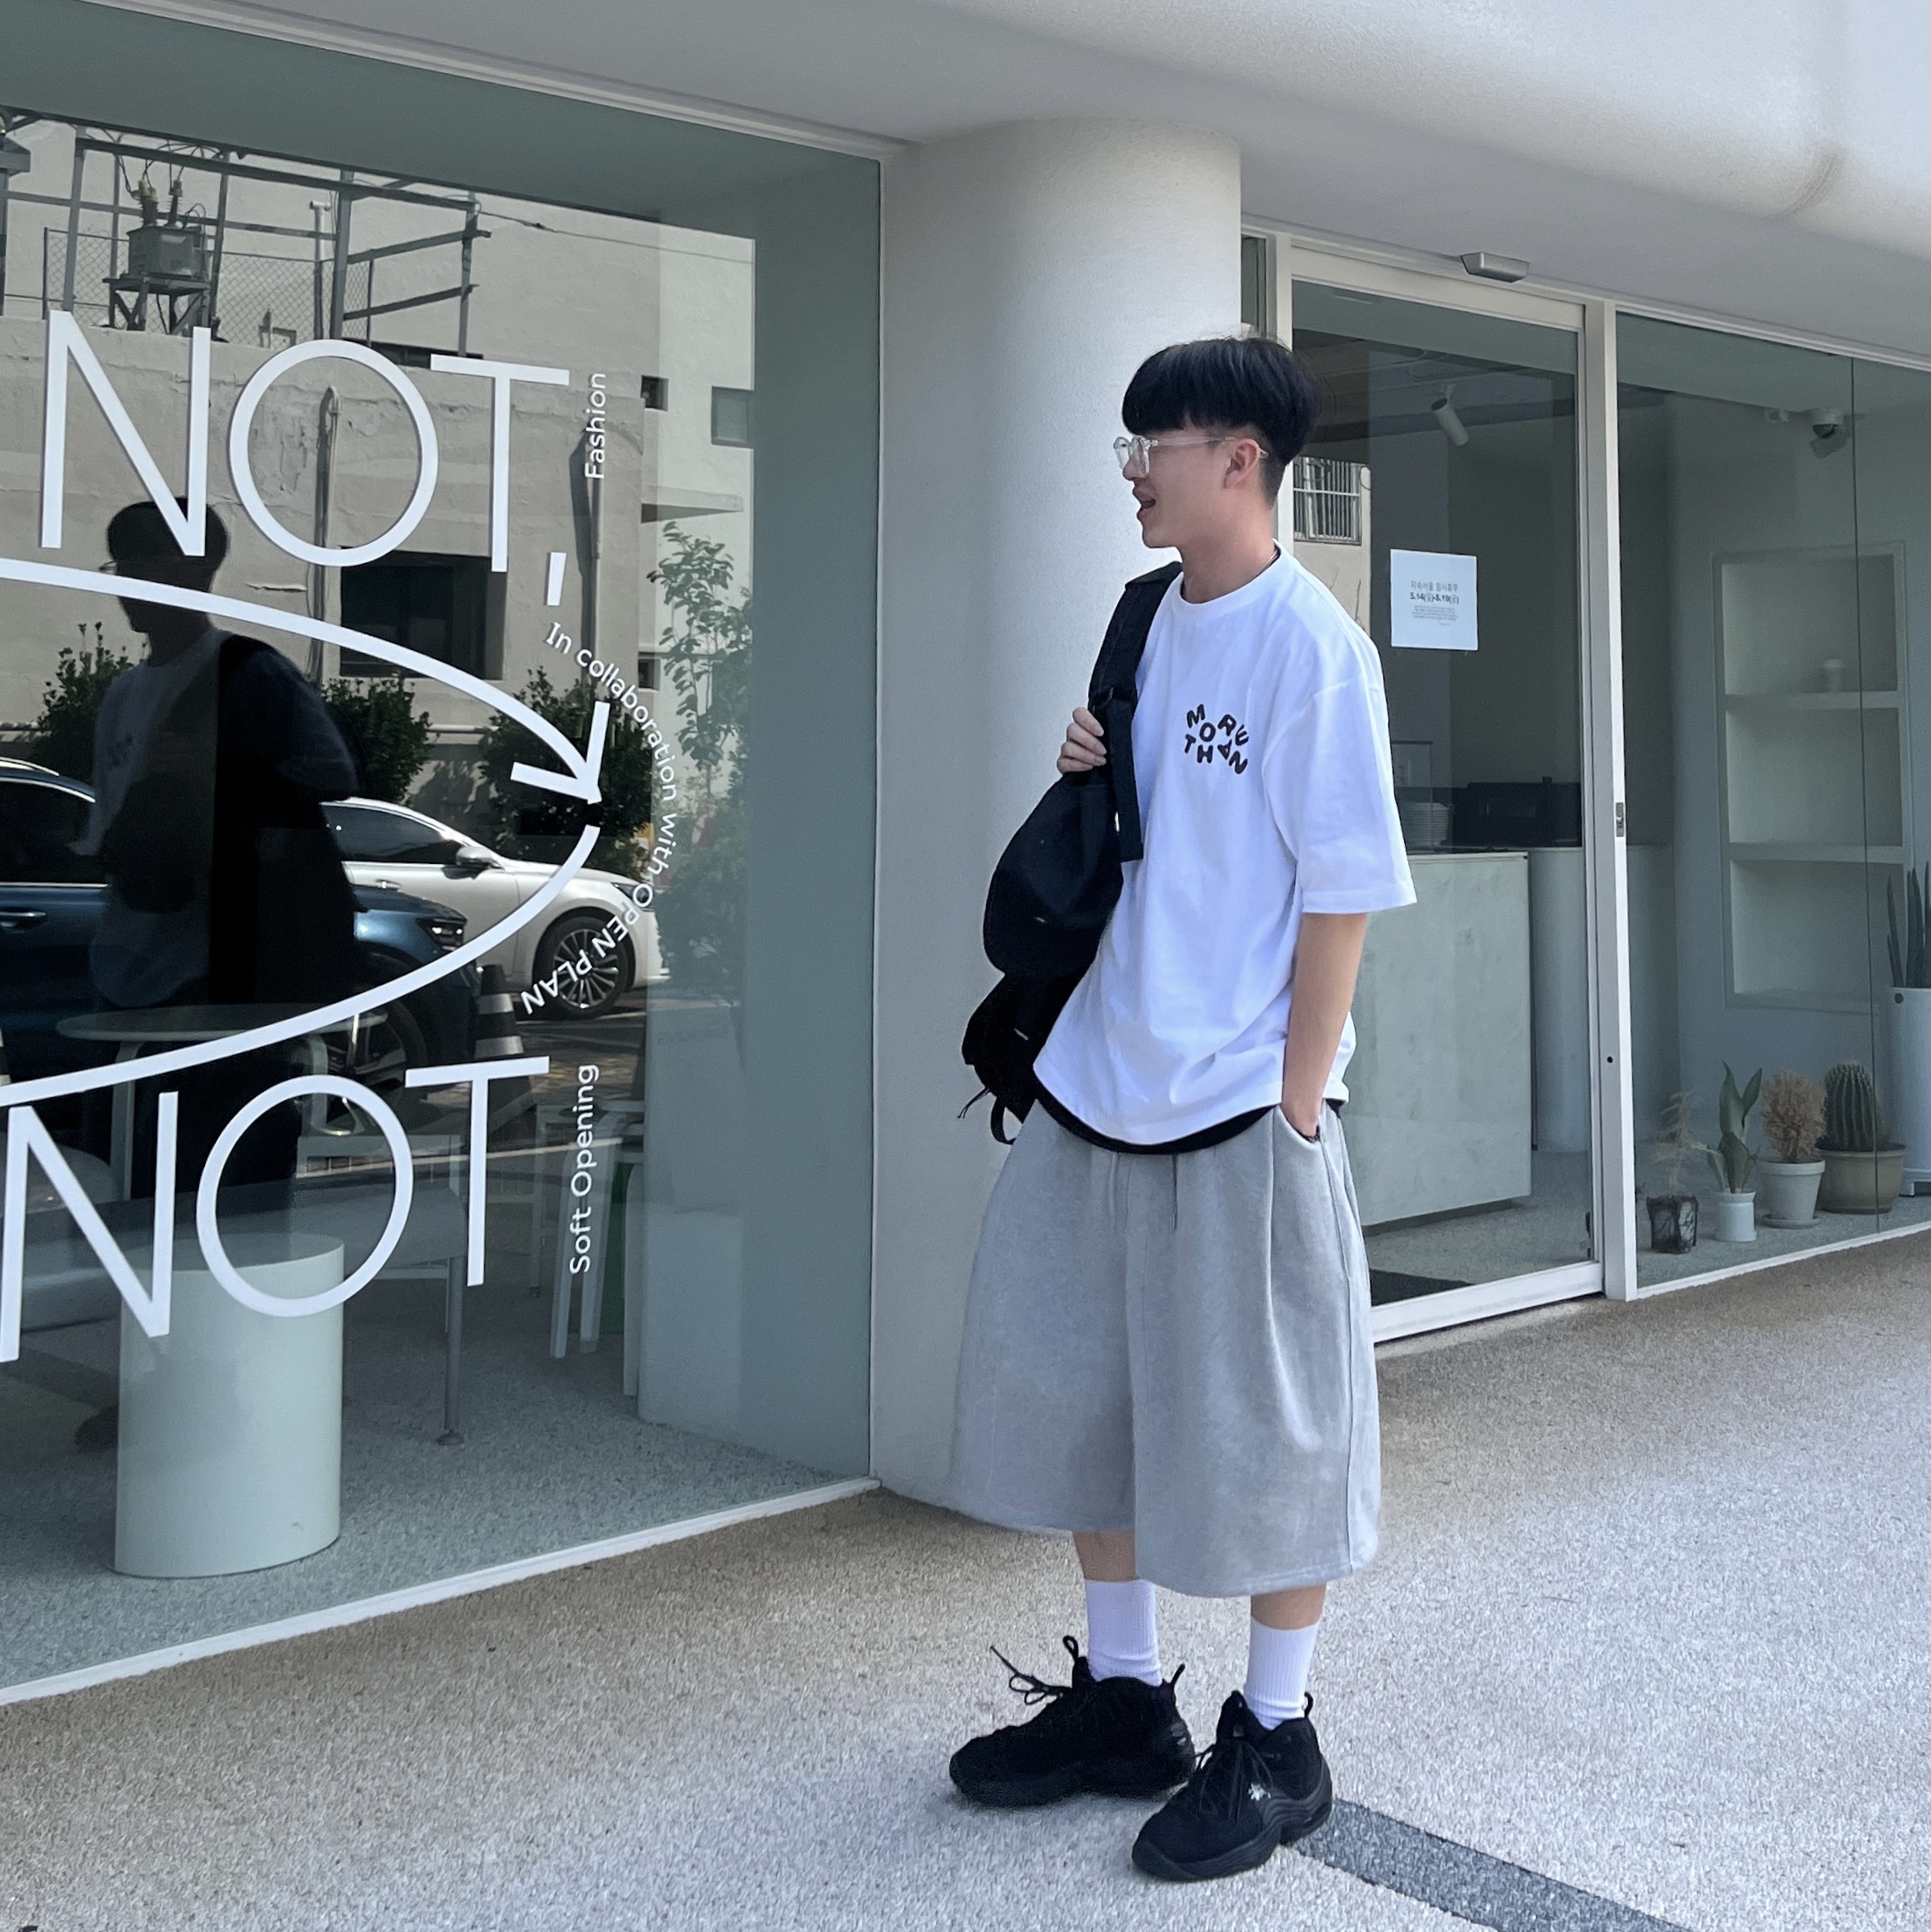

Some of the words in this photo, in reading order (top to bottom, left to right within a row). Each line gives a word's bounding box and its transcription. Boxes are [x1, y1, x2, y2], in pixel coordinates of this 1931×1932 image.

[584, 372, 606, 479] Fashion
[545, 621, 572, 655] In
[576, 648, 677, 801] collaboration
[1184, 734, 1248, 774] THAN
[1186, 704, 1249, 746] MORE
[647, 813, 677, 875] with
[592, 882, 653, 958] OPEN
[520, 948, 593, 1014] PLAN
[571, 1065, 599, 1197] Opening
[0, 1057, 550, 1362] NOT
[569, 1206, 592, 1275] Soft
